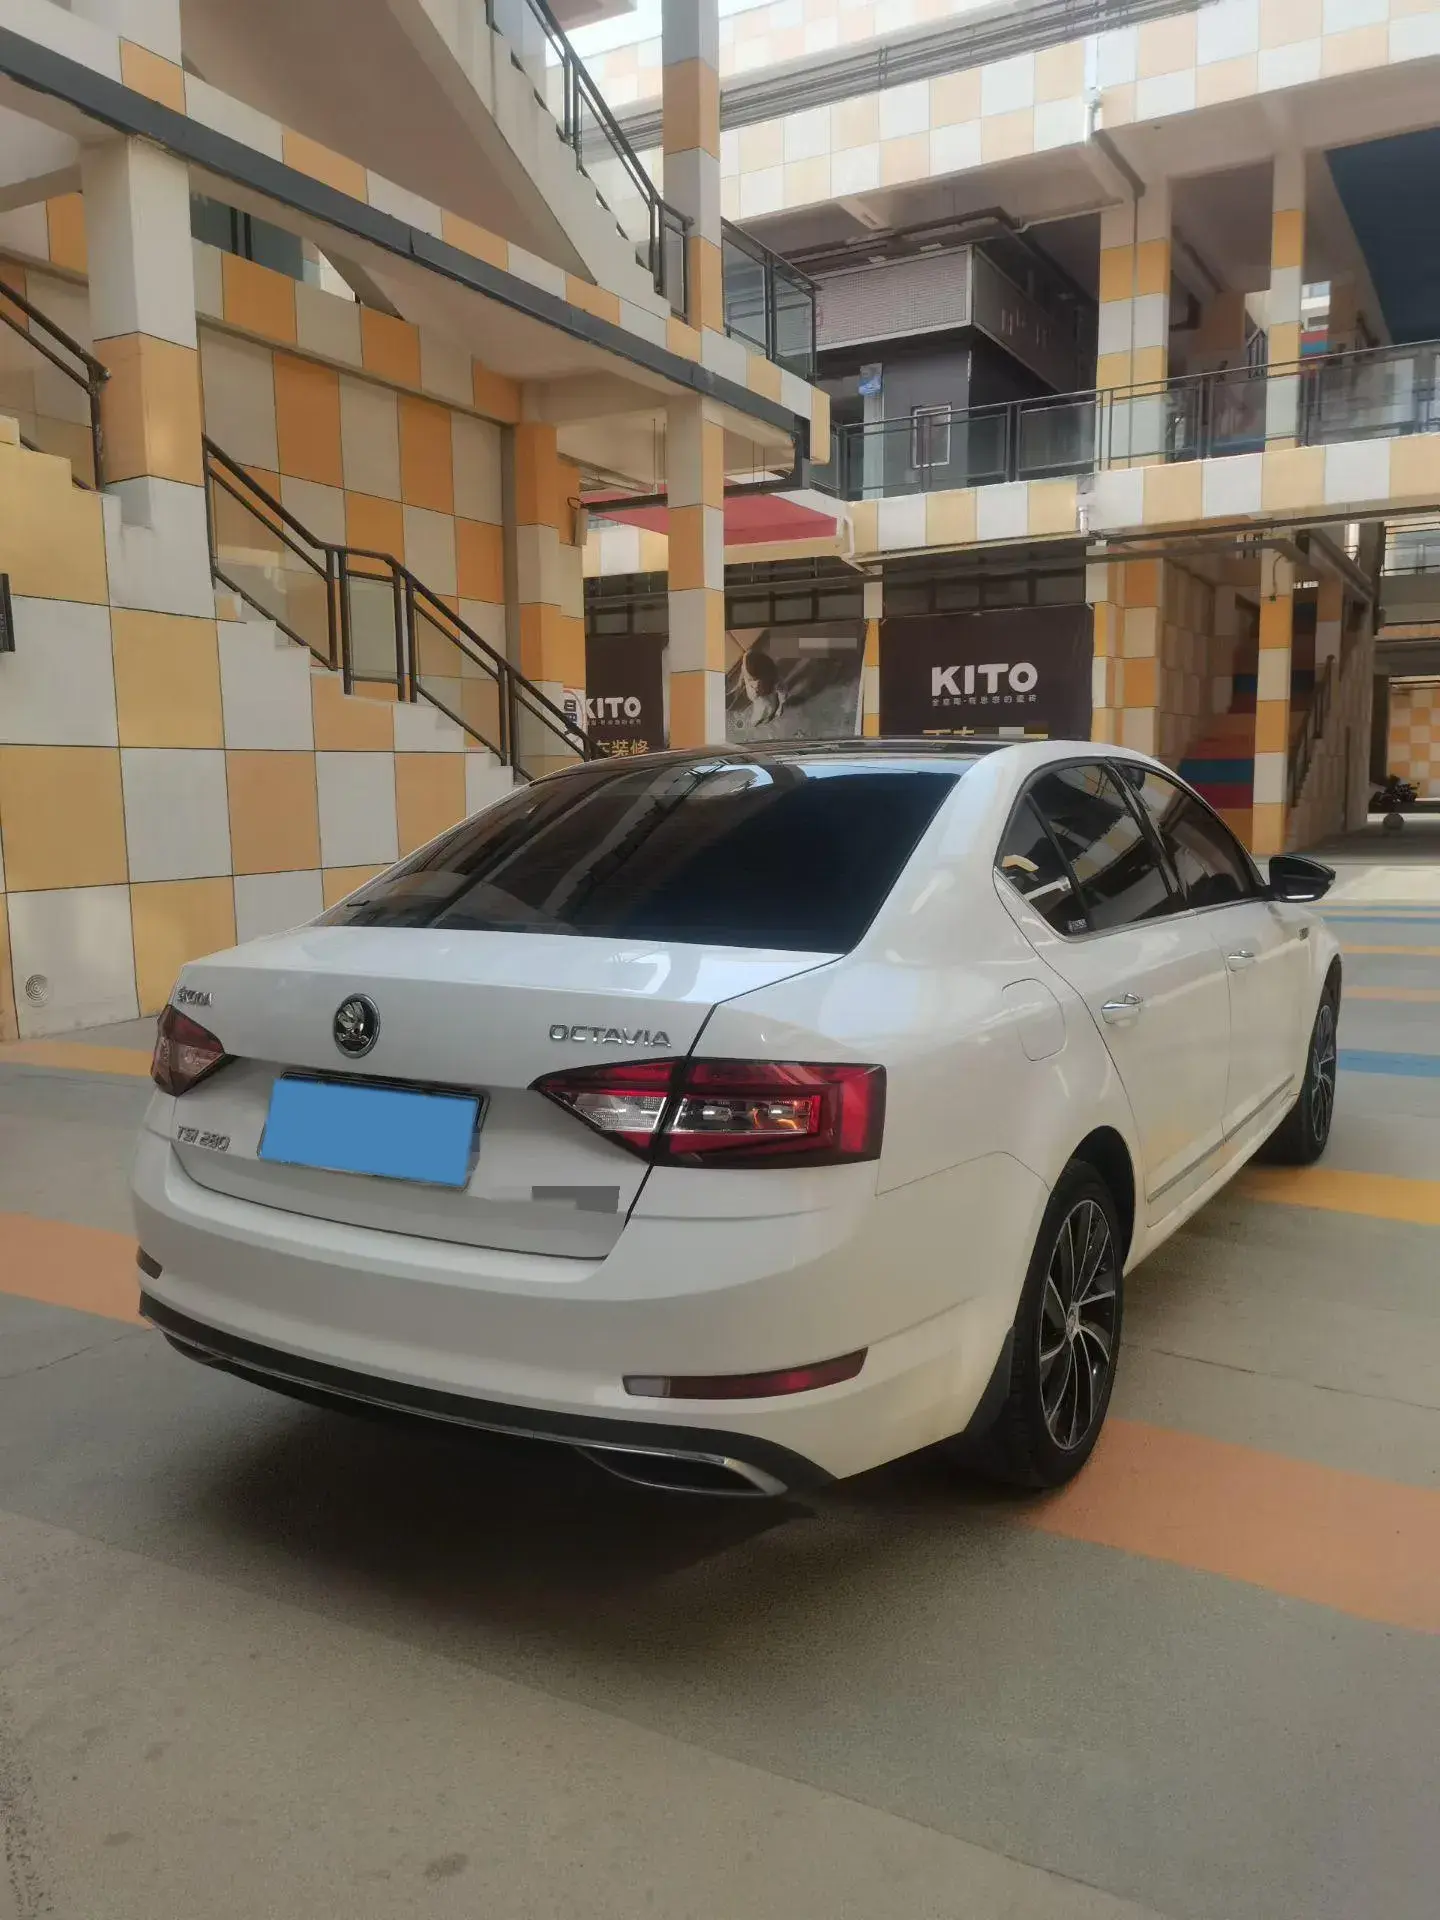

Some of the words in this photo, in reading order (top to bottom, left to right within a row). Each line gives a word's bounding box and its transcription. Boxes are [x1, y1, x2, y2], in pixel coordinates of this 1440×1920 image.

[931, 662, 1038, 697] KITO
[585, 696, 642, 719] KITO
[549, 1024, 672, 1048] OCTAVIA
